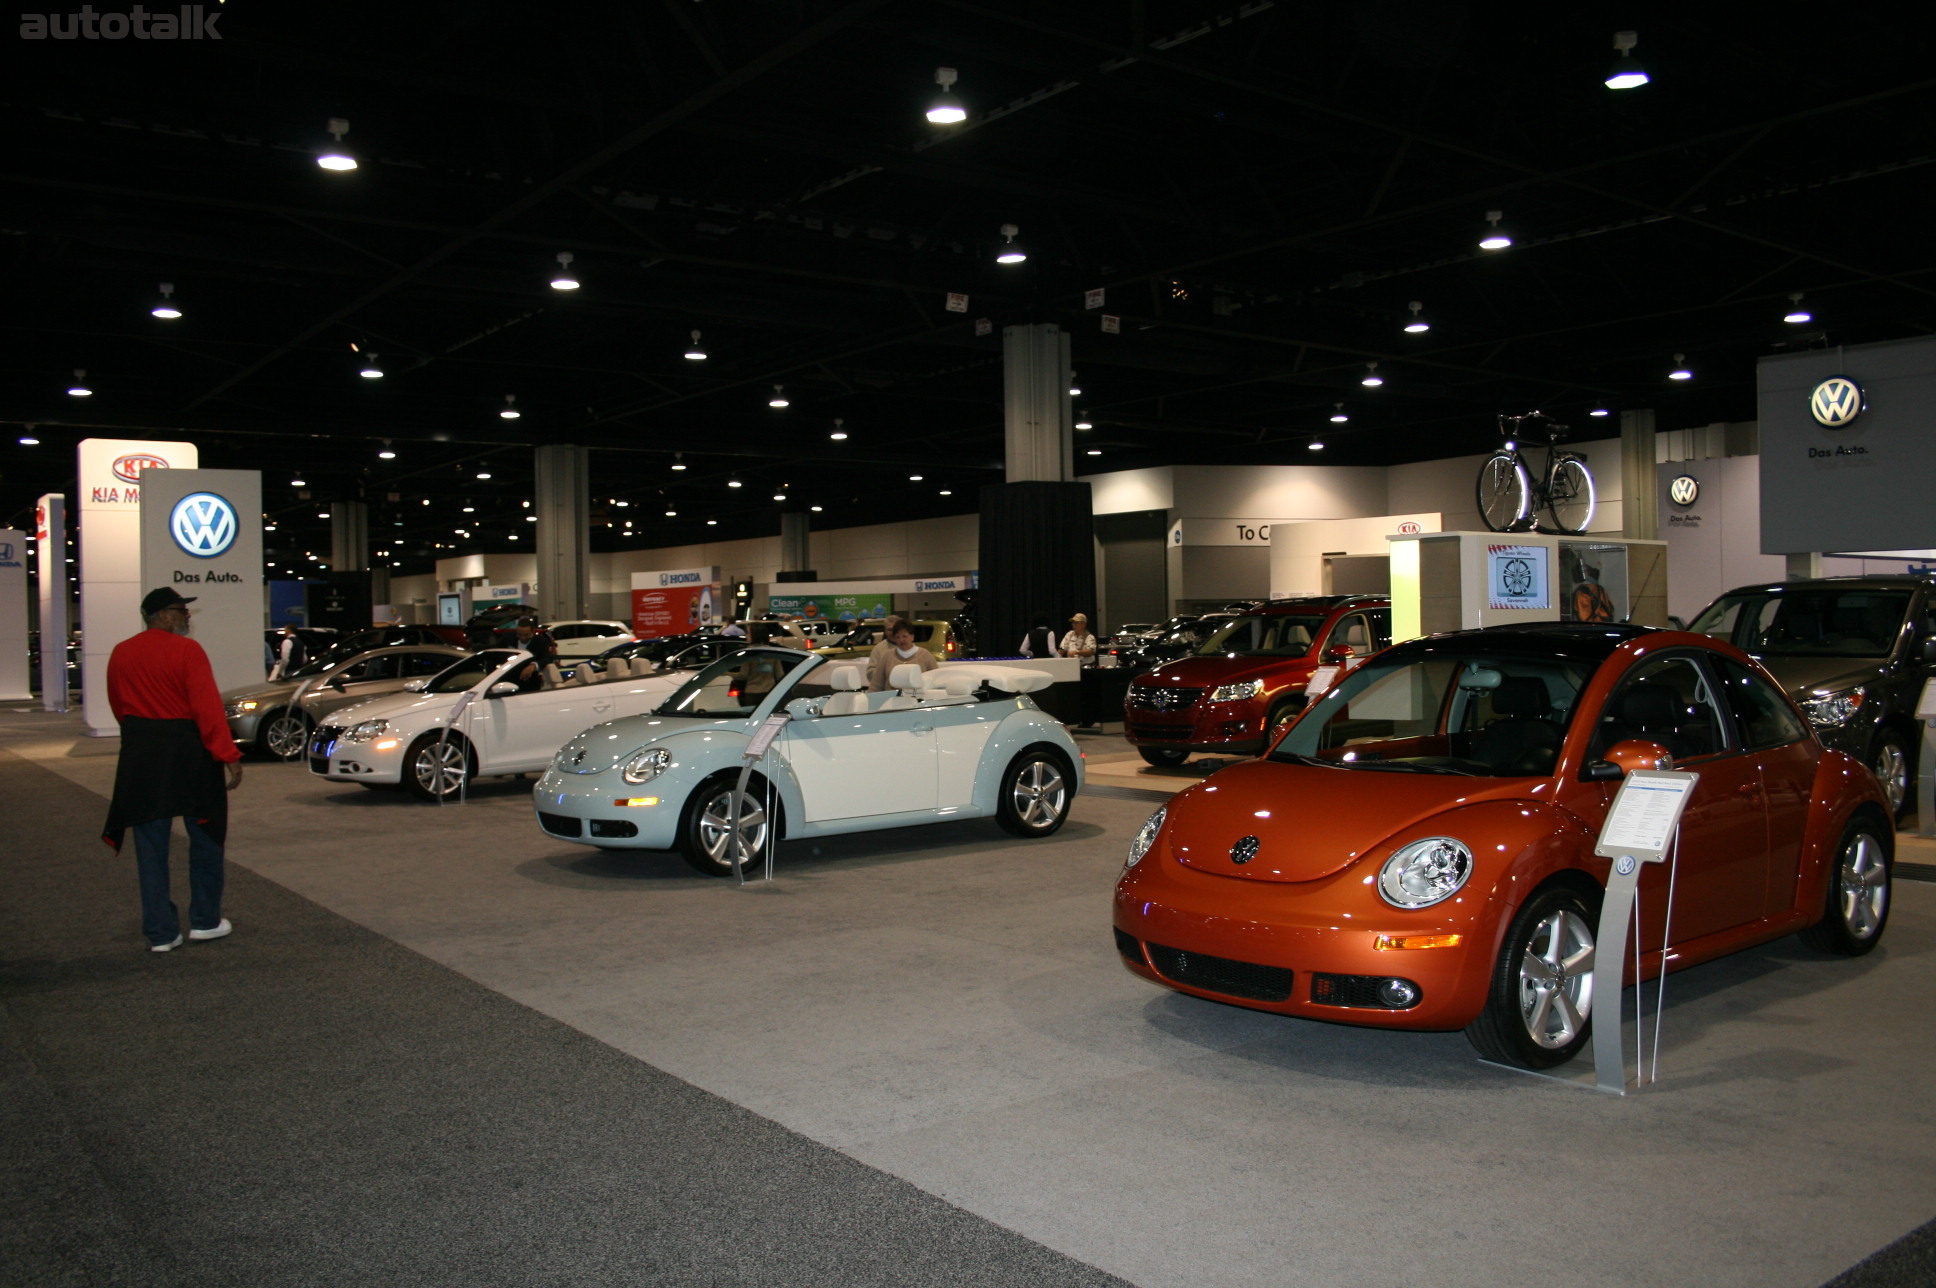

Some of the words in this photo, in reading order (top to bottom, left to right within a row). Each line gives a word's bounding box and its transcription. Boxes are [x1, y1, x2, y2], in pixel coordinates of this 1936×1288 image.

[1808, 447, 1832, 458] Das
[92, 487, 119, 502] KIA
[172, 494, 237, 557] VW
[1401, 525, 1418, 534] KIA
[1236, 525, 1255, 540] To
[1259, 525, 1270, 540] C
[173, 570, 200, 583] Das
[205, 570, 243, 583] Auto.
[669, 573, 701, 584] HONDA
[924, 580, 955, 590] HONDA
[771, 598, 799, 608] Clean
[834, 598, 856, 606] MPG
